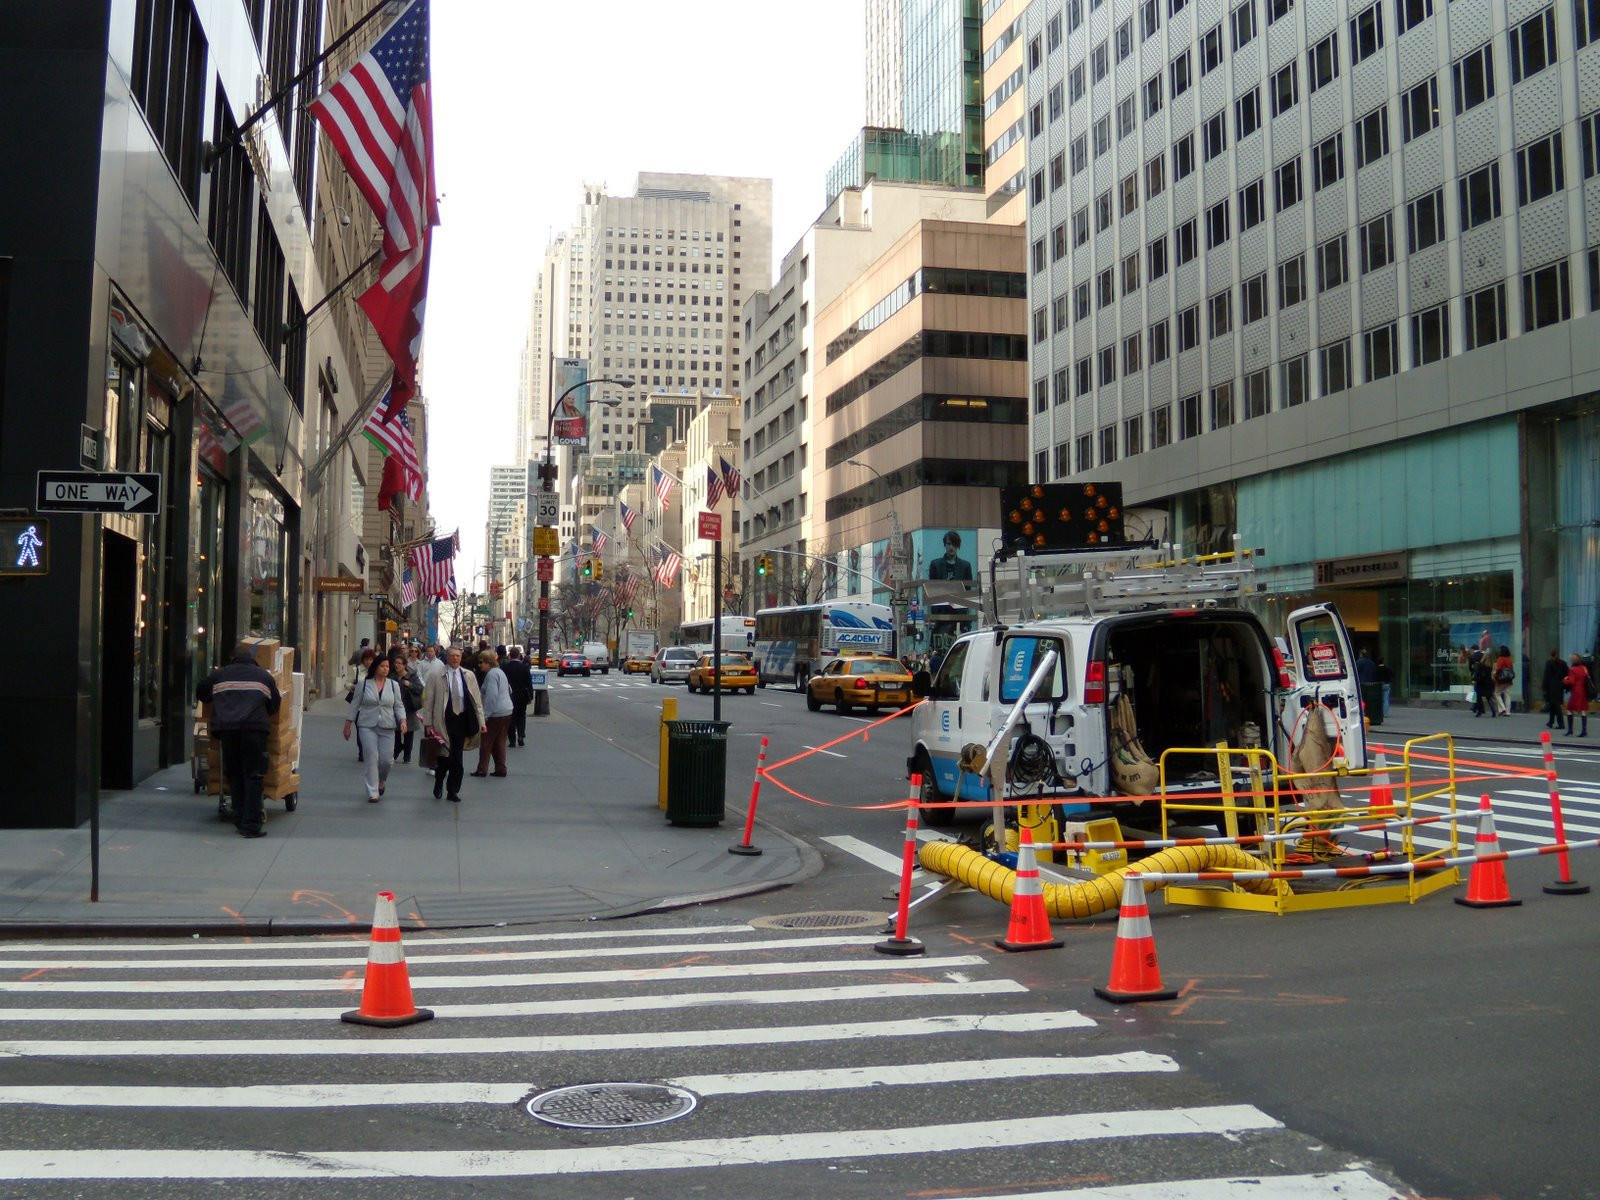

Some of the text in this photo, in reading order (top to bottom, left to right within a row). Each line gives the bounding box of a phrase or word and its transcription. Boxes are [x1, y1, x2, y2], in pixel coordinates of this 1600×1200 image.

[85, 440, 96, 458] ONE
[56, 484, 140, 501] ONE WAY
[540, 506, 556, 516] 30
[837, 633, 881, 643] ACADEMY
[1313, 648, 1334, 658] DANGER
